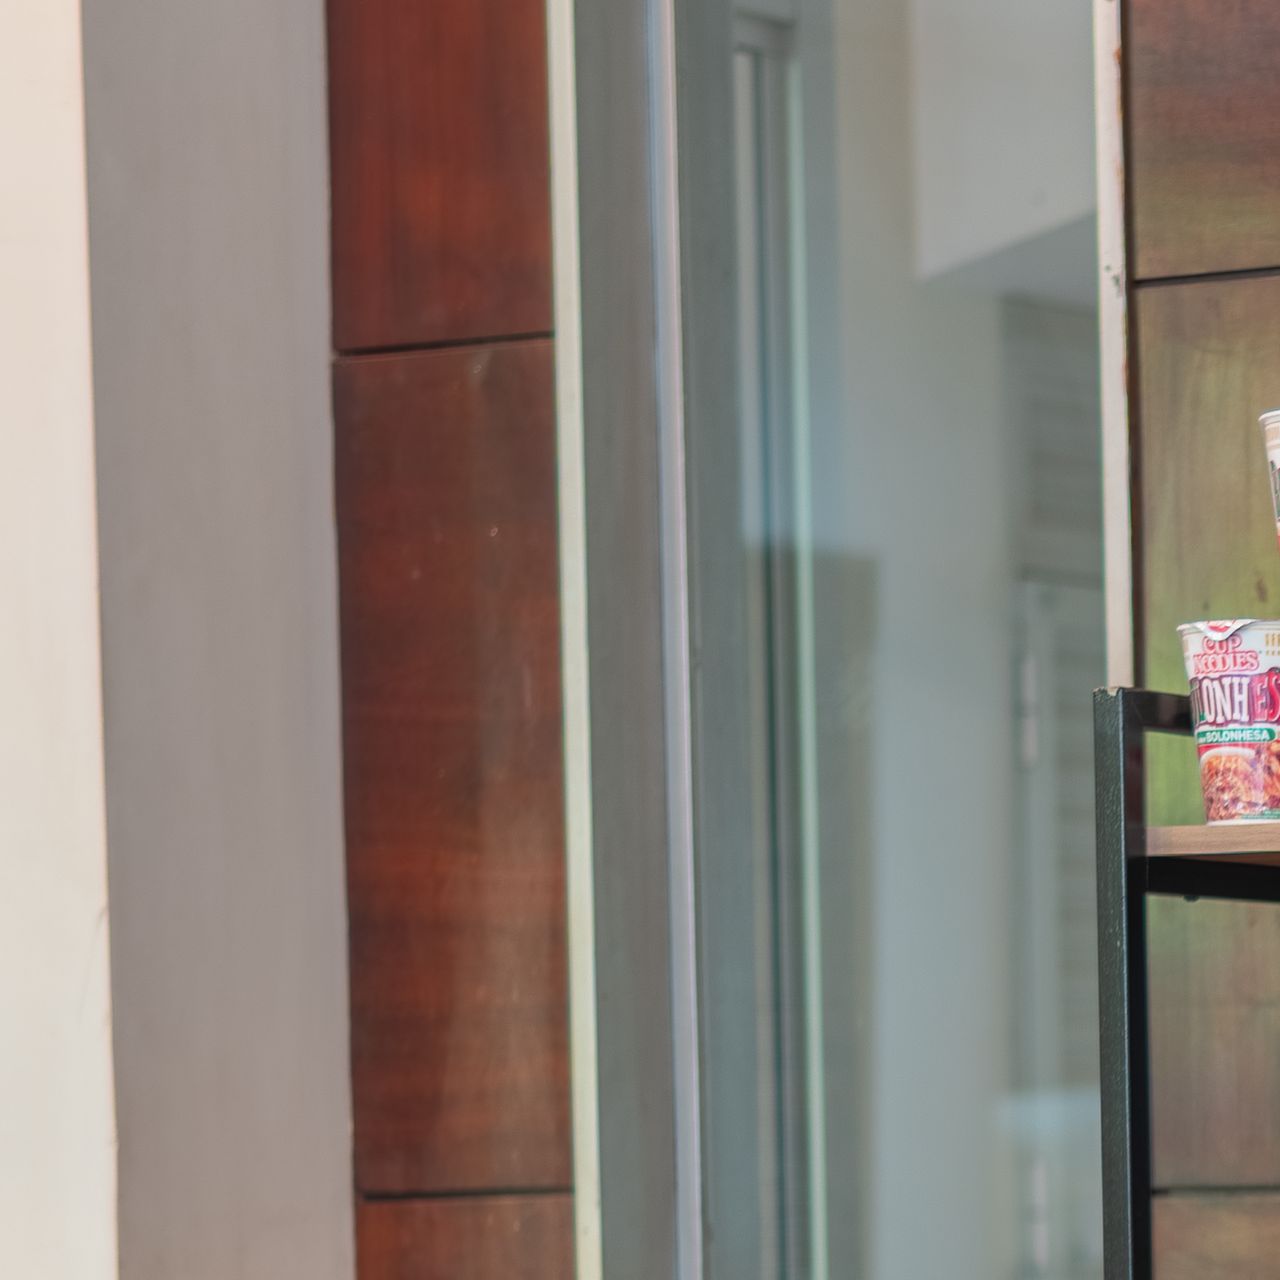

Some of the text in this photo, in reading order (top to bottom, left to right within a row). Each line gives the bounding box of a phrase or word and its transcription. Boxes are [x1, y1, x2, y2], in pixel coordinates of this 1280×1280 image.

[1202, 633, 1242, 655] CUP
[1192, 650, 1261, 674] NOODLES
[1206, 730, 1270, 742] BOLONHESA
